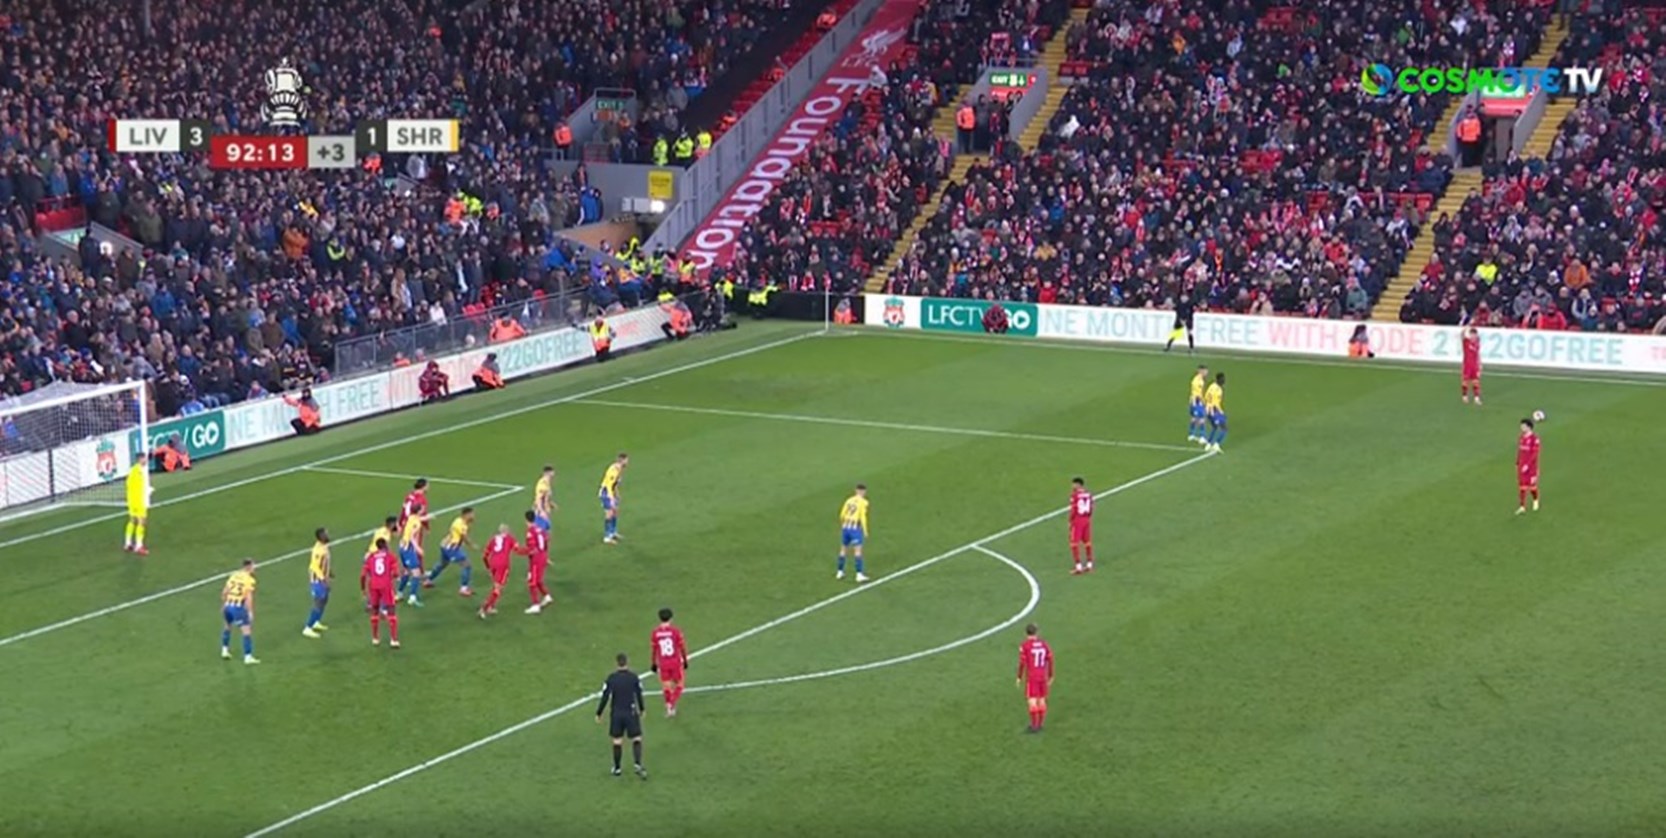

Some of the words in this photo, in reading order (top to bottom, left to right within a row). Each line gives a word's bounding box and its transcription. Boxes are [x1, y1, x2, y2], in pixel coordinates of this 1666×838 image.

[675, 77, 869, 270] Foundation
[1197, 315, 1260, 346] FREE
[1267, 320, 1338, 350] WITH
[1370, 326, 1424, 355] ODE
[658, 637, 674, 656] 18
[1030, 648, 1046, 667] 77
